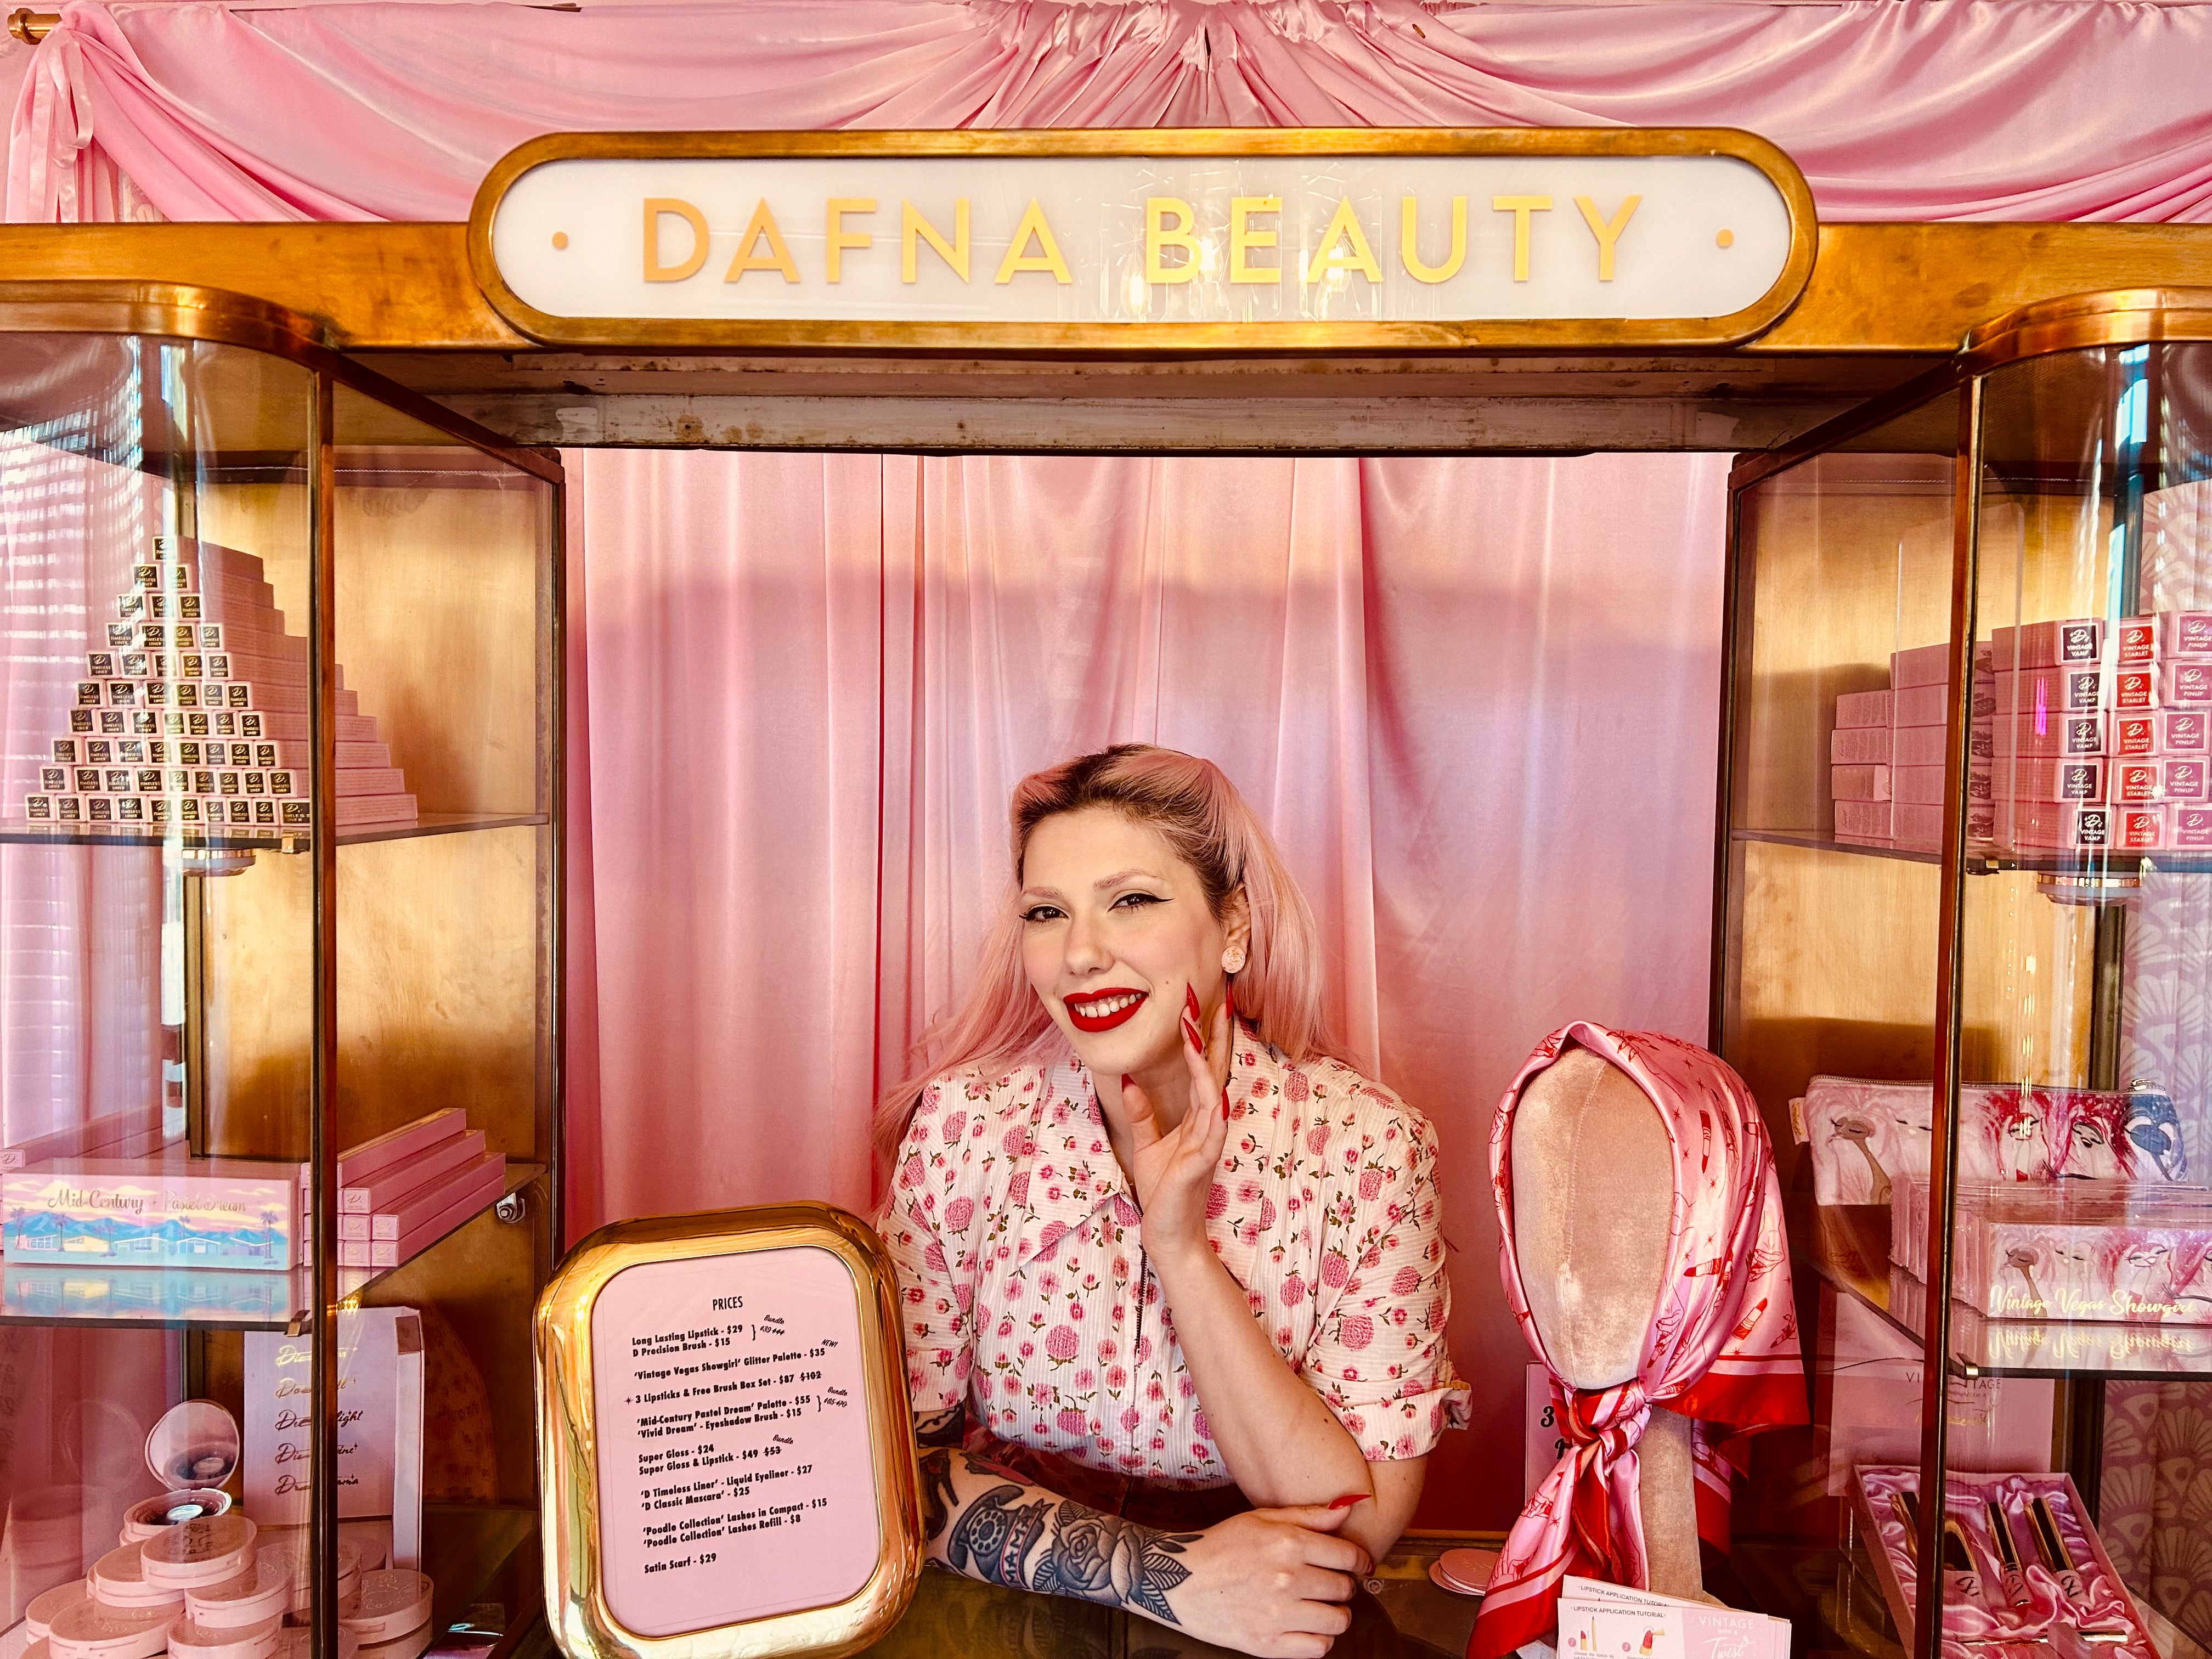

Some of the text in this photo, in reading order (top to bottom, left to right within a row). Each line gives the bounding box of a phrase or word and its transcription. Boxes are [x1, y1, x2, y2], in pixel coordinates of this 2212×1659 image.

[644, 195, 1643, 284] DAFNA BEAUTY
[2067, 642, 2093, 651] VINTAGE
[47, 1189, 247, 1215] Mid-Century Pastel Dream
[712, 1296, 743, 1311] PRICES
[1990, 1285, 2196, 1317] Vintage Vegas Showgirl
[764, 1315, 785, 1324] Bundle
[655, 1333, 685, 1342] Lasting
[688, 1327, 719, 1340] Lipstick
[727, 1324, 743, 1335] $29
[821, 1339, 838, 1347] NEW!
[641, 1345, 679, 1356] Precision
[682, 1340, 706, 1351] Brush
[715, 1338, 730, 1347] $15
[674, 1366, 699, 1375] Vegas
[744, 1357, 770, 1365] Glitter
[773, 1352, 801, 1362] Palette
[810, 1348, 825, 1358] $35
[636, 1395, 641, 1403] 3
[644, 1390, 680, 1403] Lipsticks
[684, 1389, 689, 1397] &
[693, 1387, 710, 1396] Free
[714, 1381, 737, 1393] Brush
[740, 1381, 755, 1389] Box
[779, 1374, 794, 1385] $87
[799, 1371, 822, 1381] $102
[827, 1386, 848, 1396] Bundle
[695, 1407, 721, 1419] Pastel
[758, 1400, 787, 1410] Palette
[795, 1395, 810, 1406] $55
[706, 1415, 752, 1431] Eyeshadow
[754, 1411, 778, 1422] Brush
[787, 1408, 801, 1418] $15
[773, 1435, 793, 1444] Bundle
[639, 1444, 714, 1463] Super Gloss $24
[639, 1446, 781, 1476] Super Gloss & Lipstick $49 $53
[653, 1485, 691, 1497] Timeless
[727, 1474, 752, 1486] Liquid
[755, 1470, 788, 1483] Eyeliner
[797, 1464, 812, 1475] $27
[654, 1497, 682, 1509] Classic
[733, 1487, 749, 1497] $25
[727, 1511, 755, 1522] Lashes
[758, 1508, 766, 1517] in
[769, 1503, 803, 1515] Compact
[812, 1498, 827, 1509] $15
[728, 1523, 757, 1534] Lashes
[759, 1517, 781, 1529] Refill
[790, 1514, 801, 1525] $8
[1005, 1515, 1033, 1582] MAMA
[645, 1553, 716, 1573] Satin Scarf $29
[1581, 1585, 1605, 1594] LIPSTICK
[1606, 1591, 1642, 1603] APPLICATION
[1699, 1615, 1755, 1628] VINTAGE
